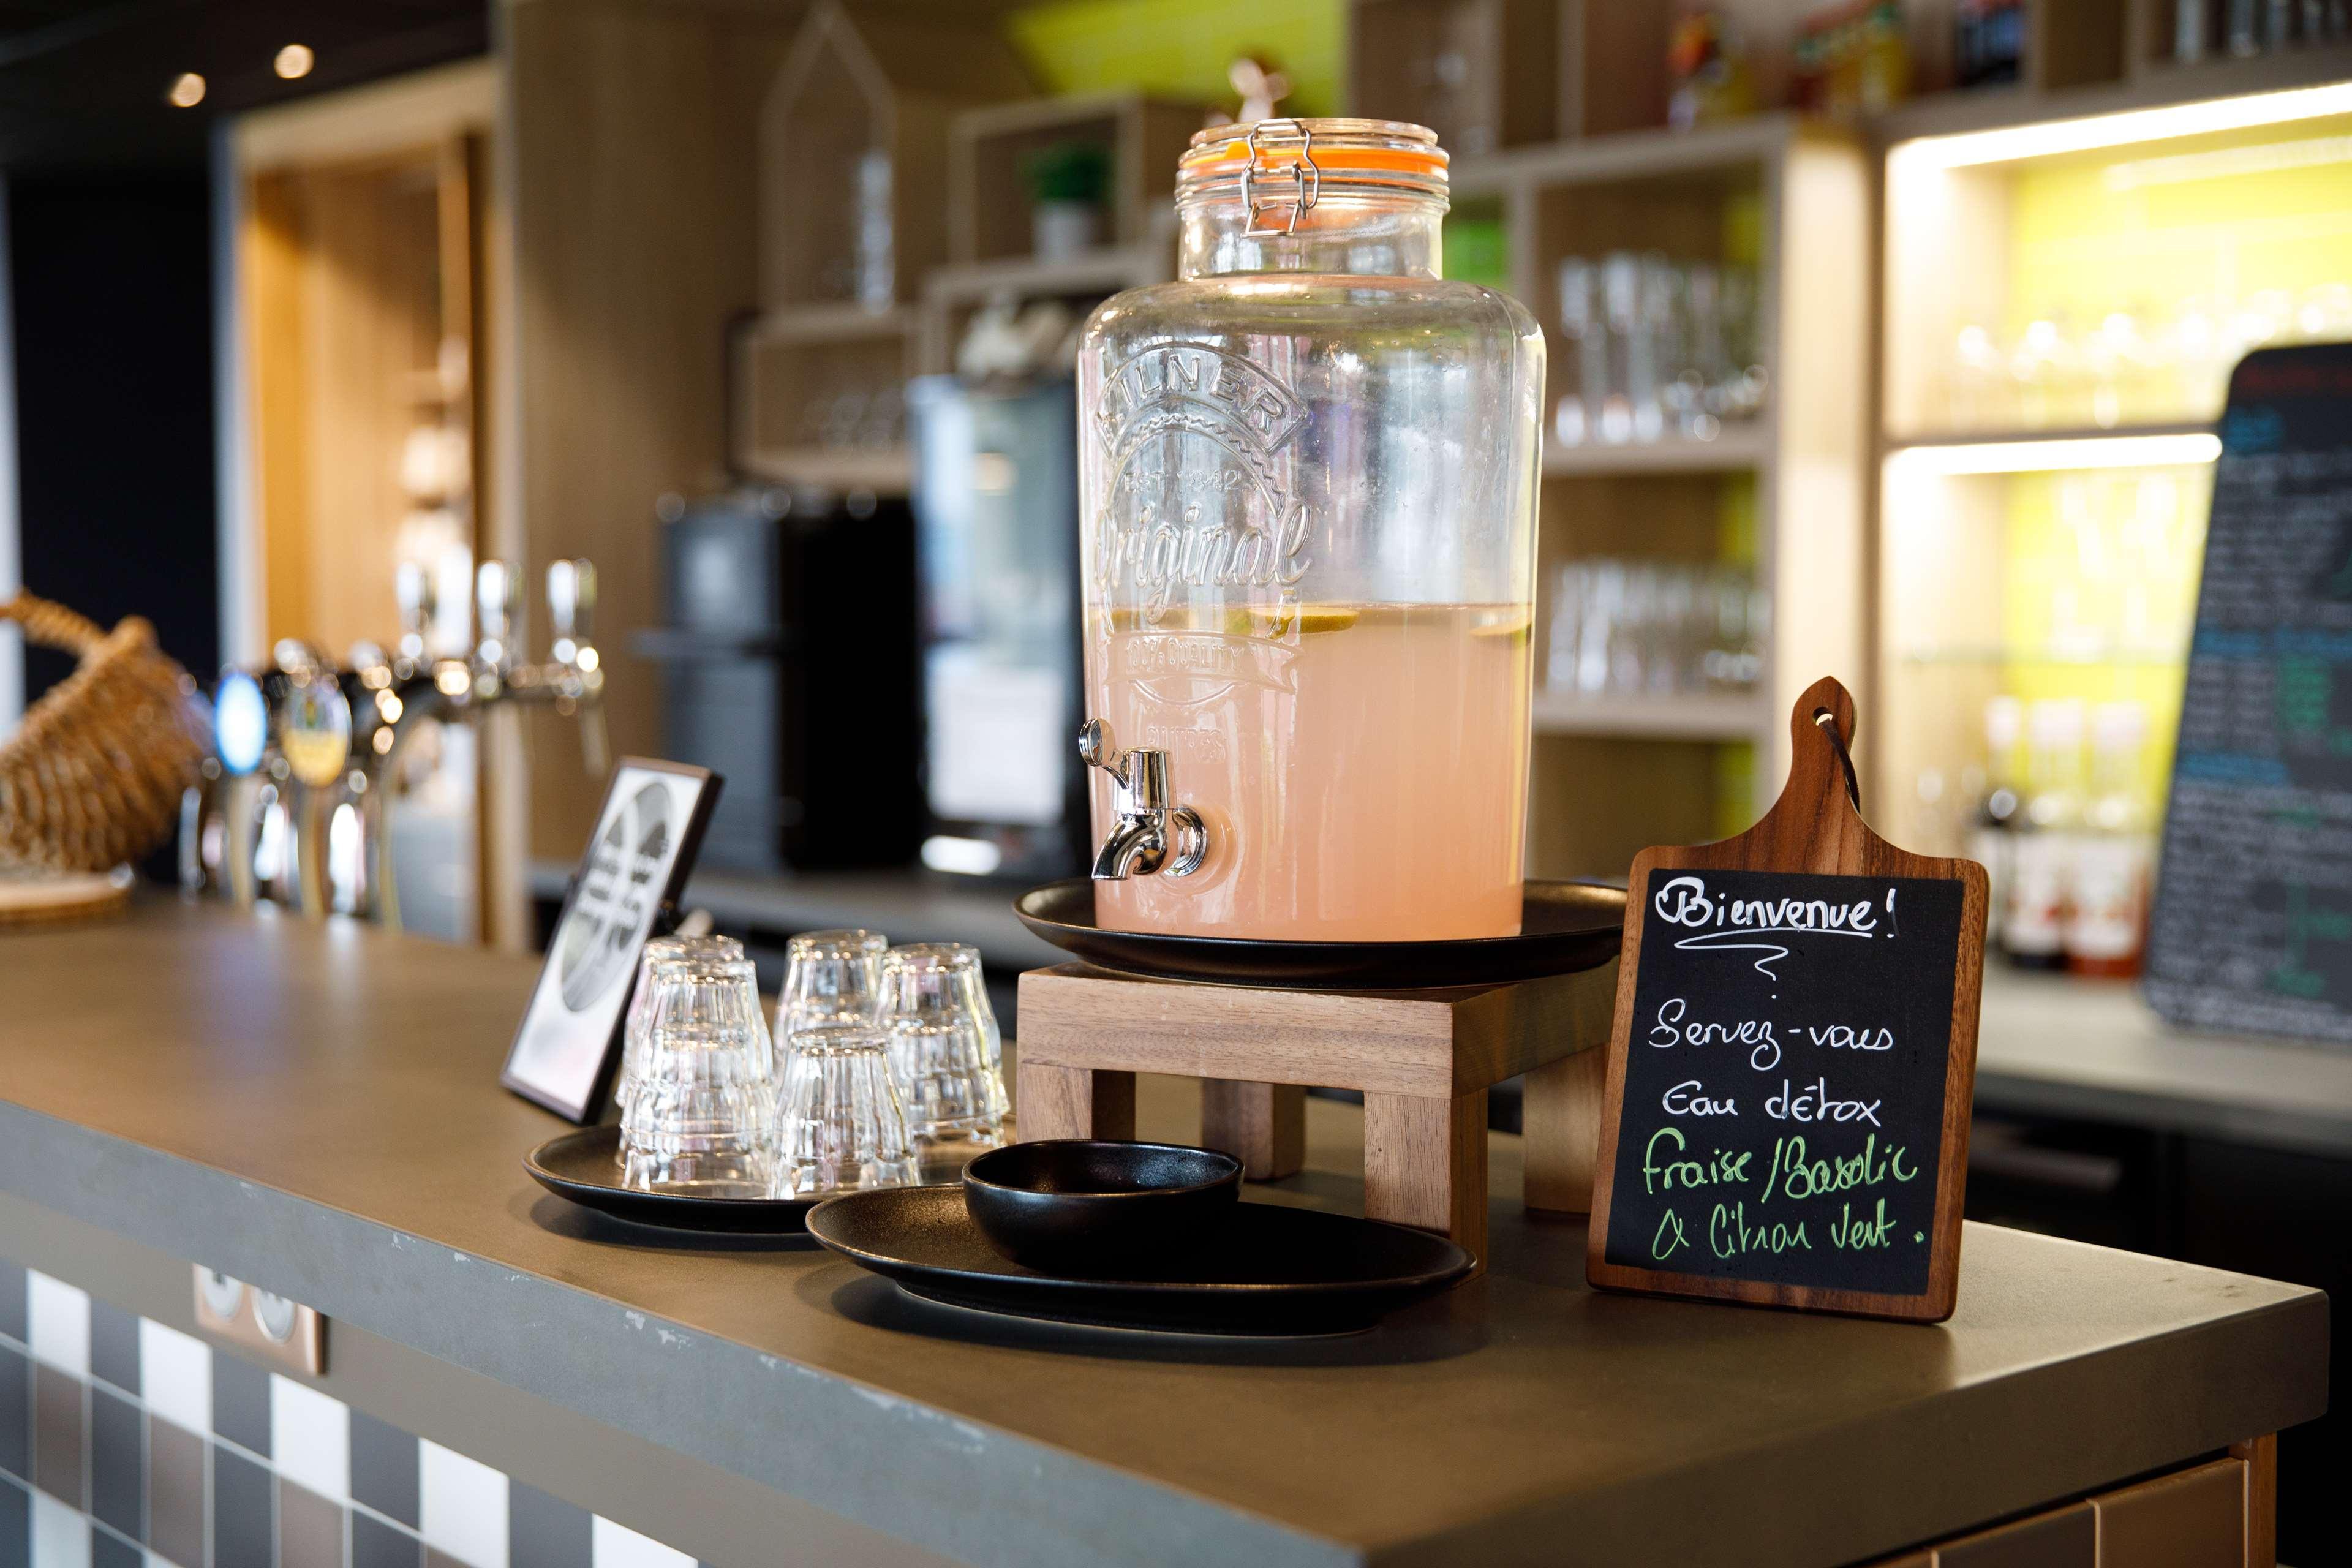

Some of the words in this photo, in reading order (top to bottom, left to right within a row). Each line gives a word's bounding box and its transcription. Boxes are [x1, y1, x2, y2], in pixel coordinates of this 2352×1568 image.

[1125, 470, 1164, 492] EST
[1095, 499, 1312, 624] Original
[1662, 1080, 1738, 1116] Eau
